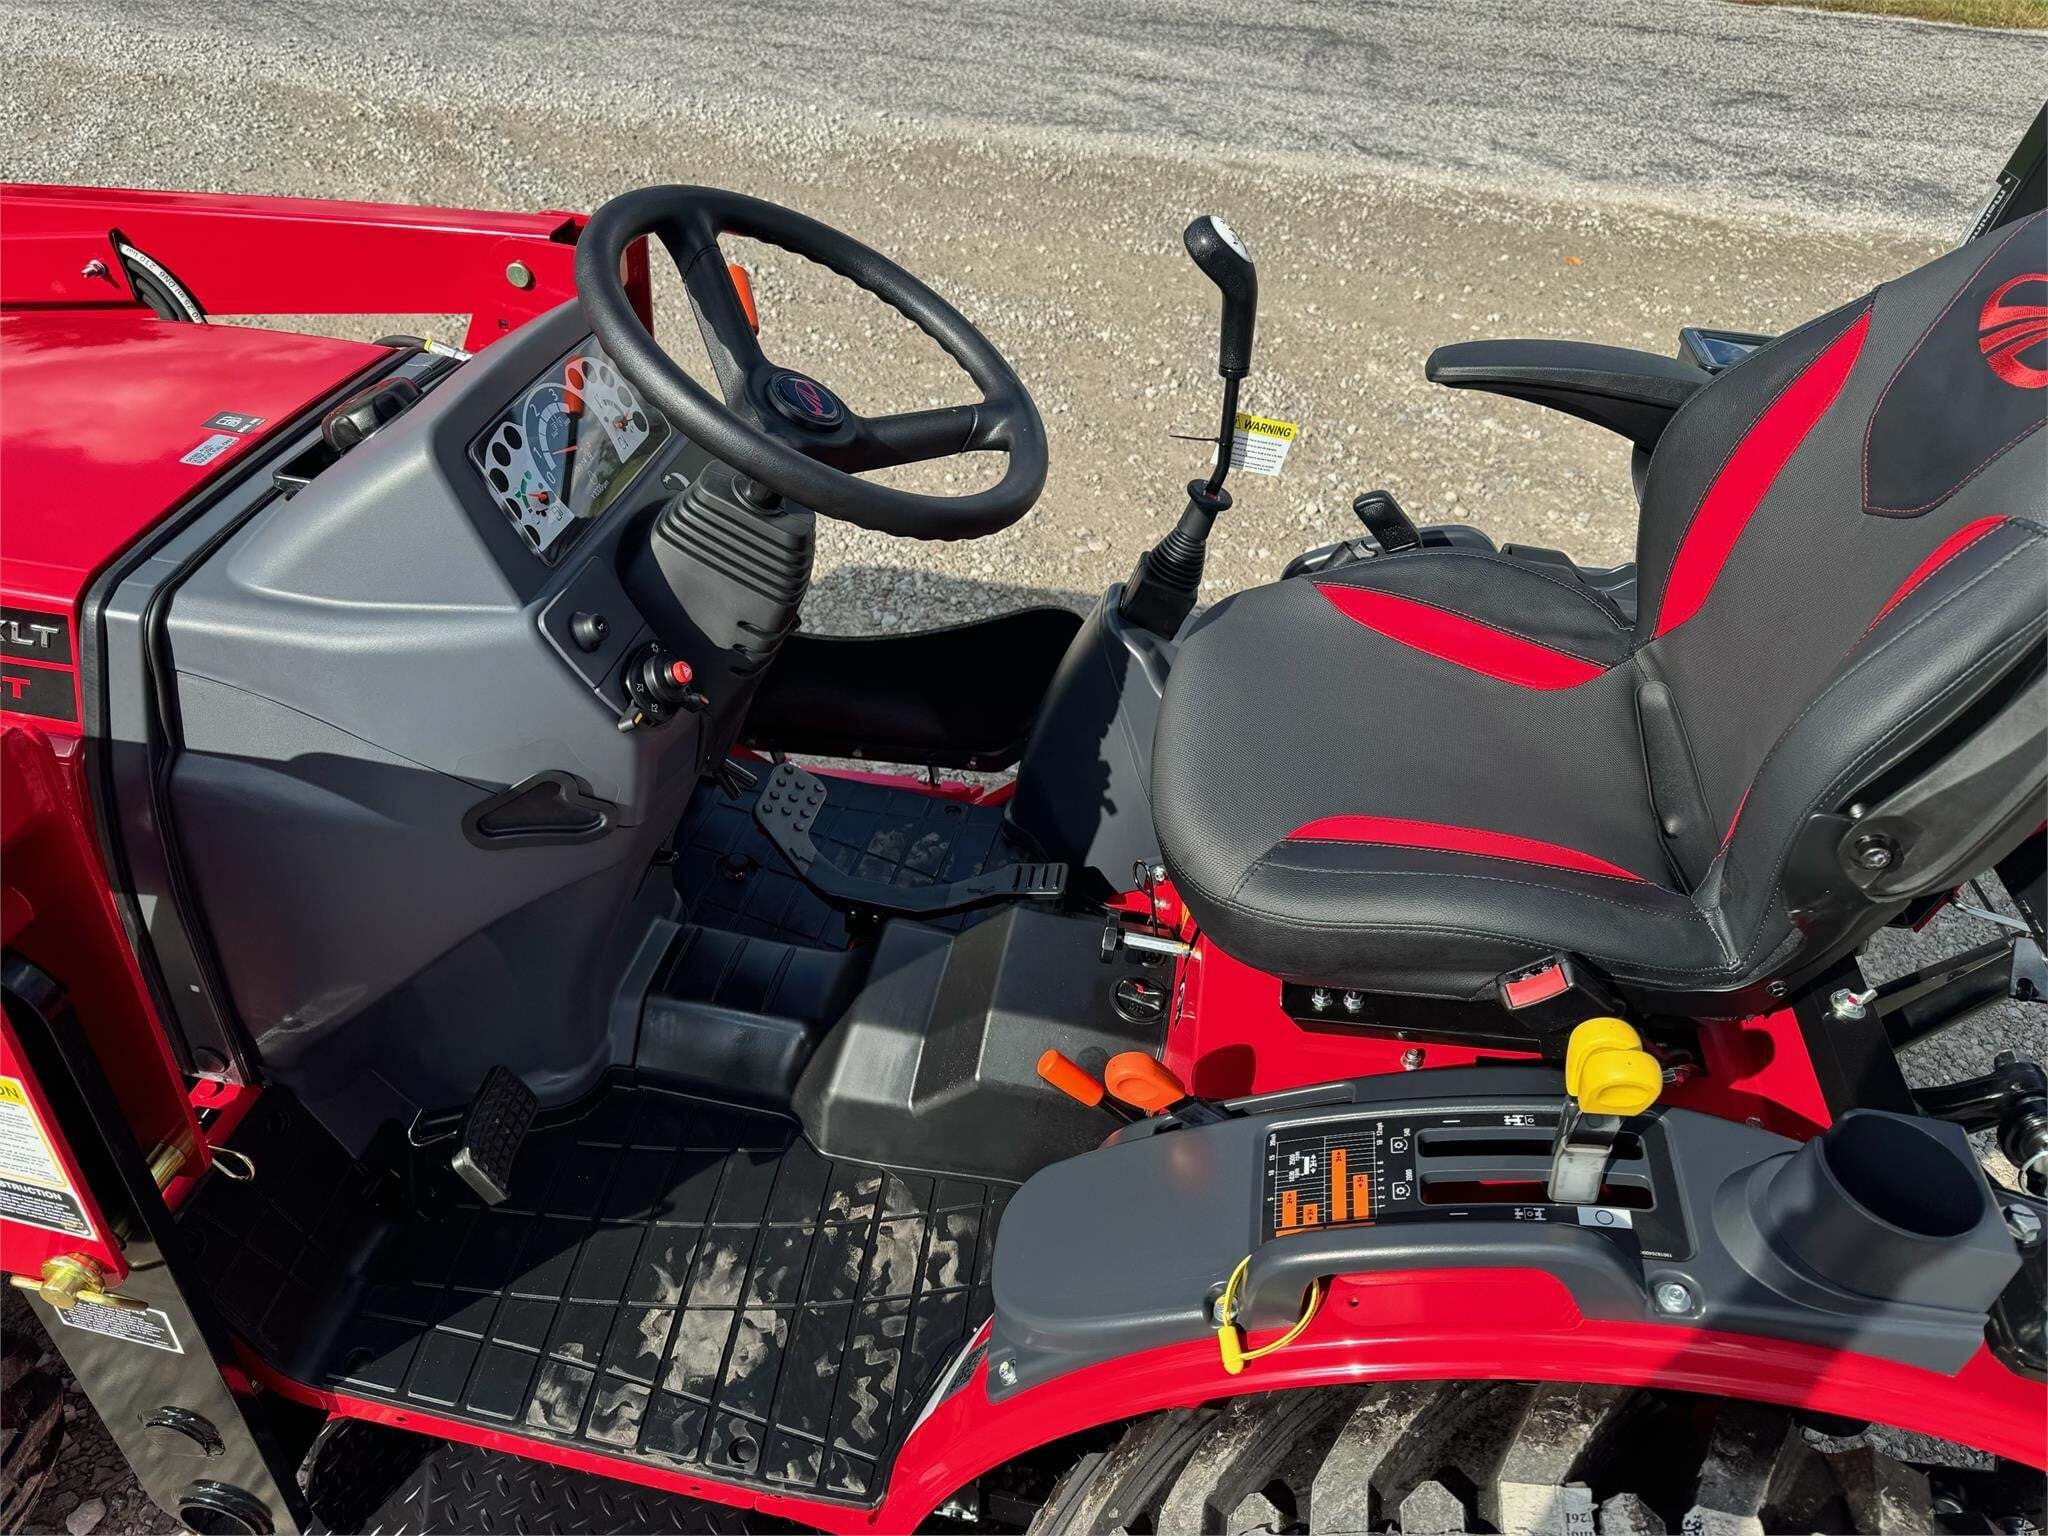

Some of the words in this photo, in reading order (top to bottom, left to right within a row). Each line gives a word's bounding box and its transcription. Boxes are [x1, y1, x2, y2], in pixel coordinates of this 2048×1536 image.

[140, 256, 156, 270] 210
[548, 388, 559, 402] 3
[529, 403, 541, 417] 2
[1244, 419, 1292, 437] WARNING
